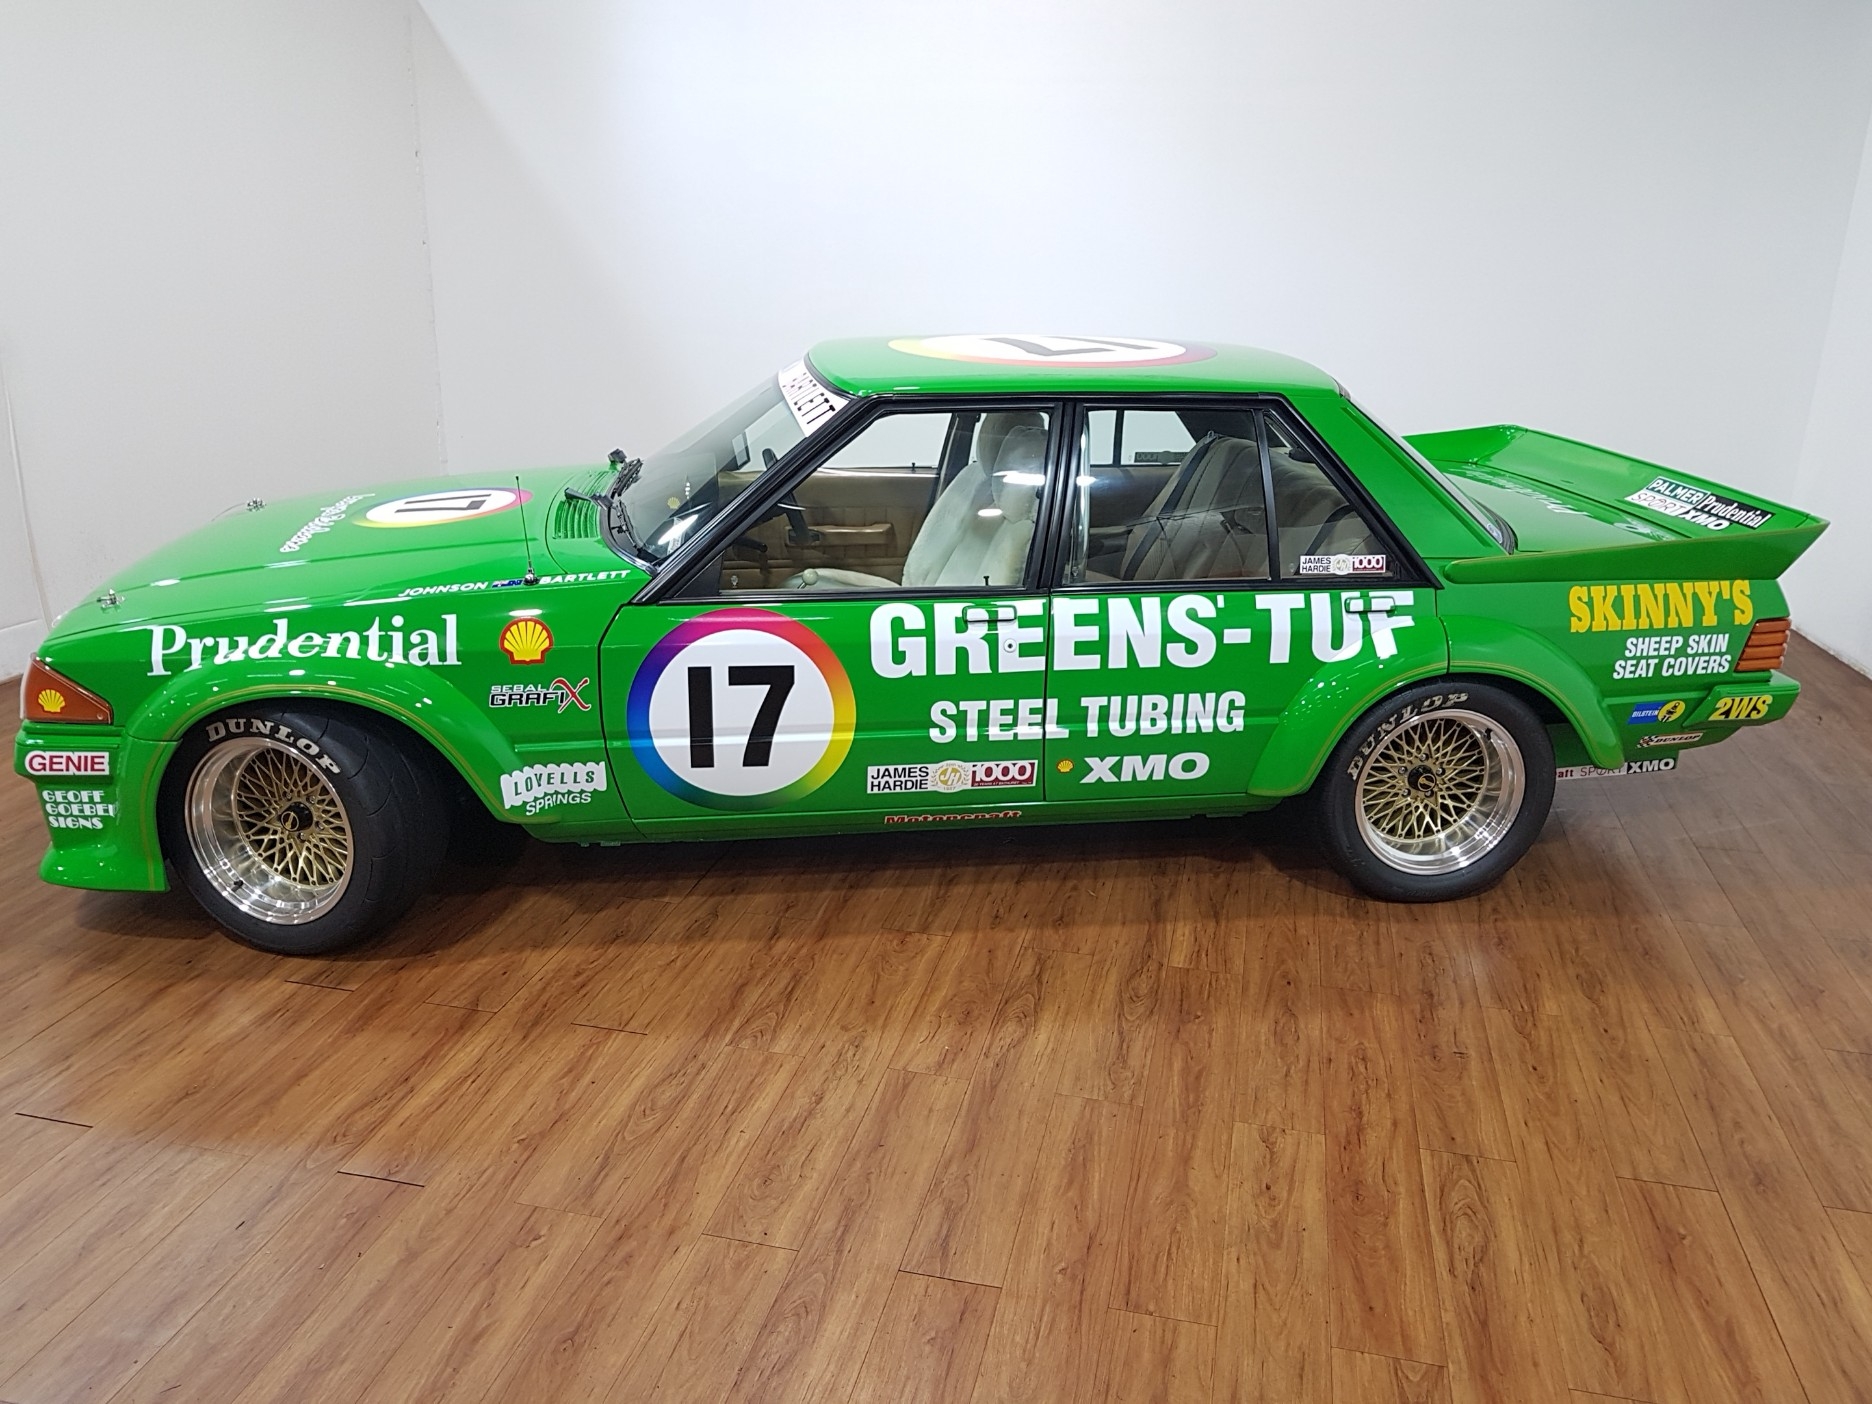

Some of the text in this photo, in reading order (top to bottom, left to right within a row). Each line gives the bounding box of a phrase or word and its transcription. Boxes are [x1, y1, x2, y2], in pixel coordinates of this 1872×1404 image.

[1630, 492, 1687, 514] SPORT
[1648, 479, 1705, 505] PALMER
[1681, 509, 1731, 531] XMO
[1699, 494, 1772, 529] Prudential
[1302, 557, 1331, 565] JAMES
[1352, 556, 1383, 569] 1000
[398, 569, 631, 597] JOHNSON BARTLETT
[1568, 579, 1754, 634] SKINNY'S
[146, 613, 463, 677] Prudential
[1624, 633, 1730, 657] SHEEP SKIN
[1612, 655, 1731, 680] SEAT COVERS
[490, 684, 547, 693] SEBAL
[687, 665, 796, 769] 17
[928, 690, 1247, 744] STEEL TUBING
[1707, 694, 1773, 721] 2WS
[205, 718, 342, 775] DUNLOP
[1346, 692, 1469, 781] DUNLOP
[1653, 734, 1702, 744] DUNLOP
[28, 754, 106, 773] GENIE
[871, 766, 930, 780] JAMES
[971, 761, 1032, 782] 1000
[1079, 752, 1211, 784] XMO
[1627, 758, 1675, 774] XMO
[513, 770, 596, 797] LOVELLS
[870, 779, 929, 792] HARDIE
[42, 789, 104, 803] GEOFF
[525, 793, 592, 816] SPRINGS
[48, 815, 104, 830] SIGNS
